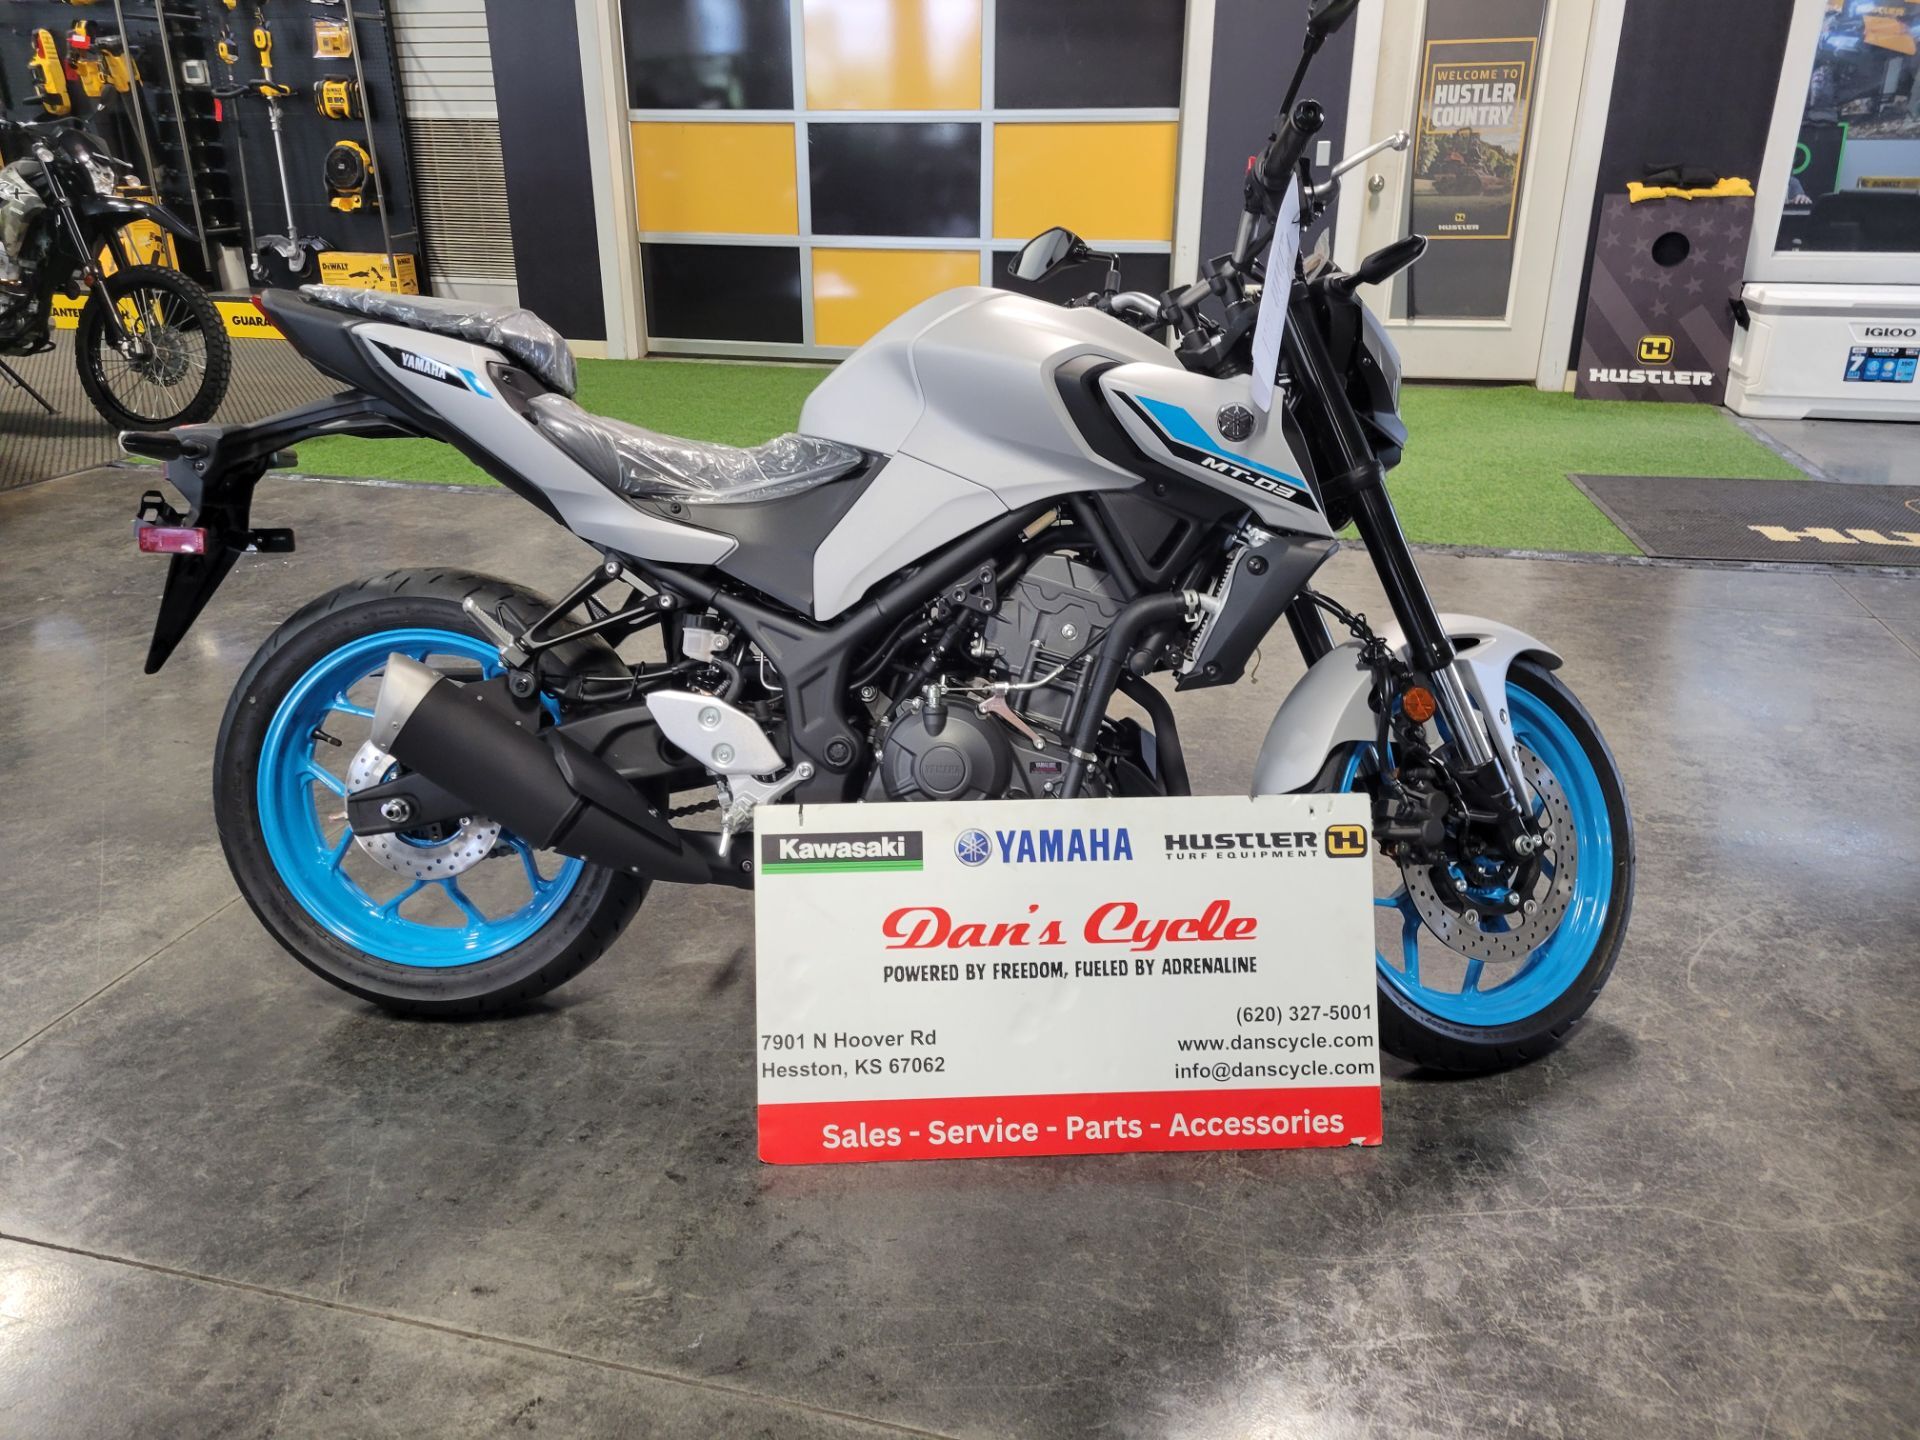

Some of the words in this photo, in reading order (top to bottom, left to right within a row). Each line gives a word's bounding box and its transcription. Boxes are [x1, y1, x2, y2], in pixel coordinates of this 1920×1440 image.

[1437, 70, 1498, 80] WELCOME
[1503, 69, 1518, 79] TO
[1434, 83, 1516, 104] HUSTLER
[1432, 105, 1513, 127] COUNTRY
[1865, 327, 1917, 337] IGLOO
[401, 352, 446, 379] YAMAHA
[1589, 368, 1712, 386] HUSTLER
[1201, 457, 1297, 499] MT-03
[779, 836, 905, 860] Kawasaki
[995, 828, 1133, 863] YAMAHA
[1164, 831, 1318, 850] HUSTLER
[1165, 852, 1208, 860] TURF
[1216, 850, 1318, 859] EQUIPMENT
[882, 904, 1067, 949] Dan's
[1084, 900, 1258, 952] Cycle
[883, 964, 959, 983] POWERED
[965, 963, 986, 980] BY
[993, 961, 1069, 980] FREEDOM,
[1075, 959, 1128, 978] FUELED
[1135, 958, 1155, 976] BY
[1162, 956, 1258, 975] ADRENALINE
[1236, 1006, 1283, 1027] (620)
[1289, 1005, 1372, 1021] 327-5001
[761, 1034, 805, 1050] 7901
[813, 1033, 827, 1049] N
[834, 1032, 905, 1048] Hoover
[911, 1029, 936, 1046] Rd
[1177, 1033, 1374, 1053] www.danscycle.com
[762, 1062, 849, 1079] Hesston,
[855, 1059, 882, 1075] KS
[889, 1057, 945, 1074] 67062
[1175, 1060, 1375, 1082] info@danscycle.com
[822, 1122, 902, 1149] Sales
[928, 1117, 1039, 1146] Service
[1066, 1116, 1143, 1140] Parts
[1168, 1108, 1345, 1138] Accessories
